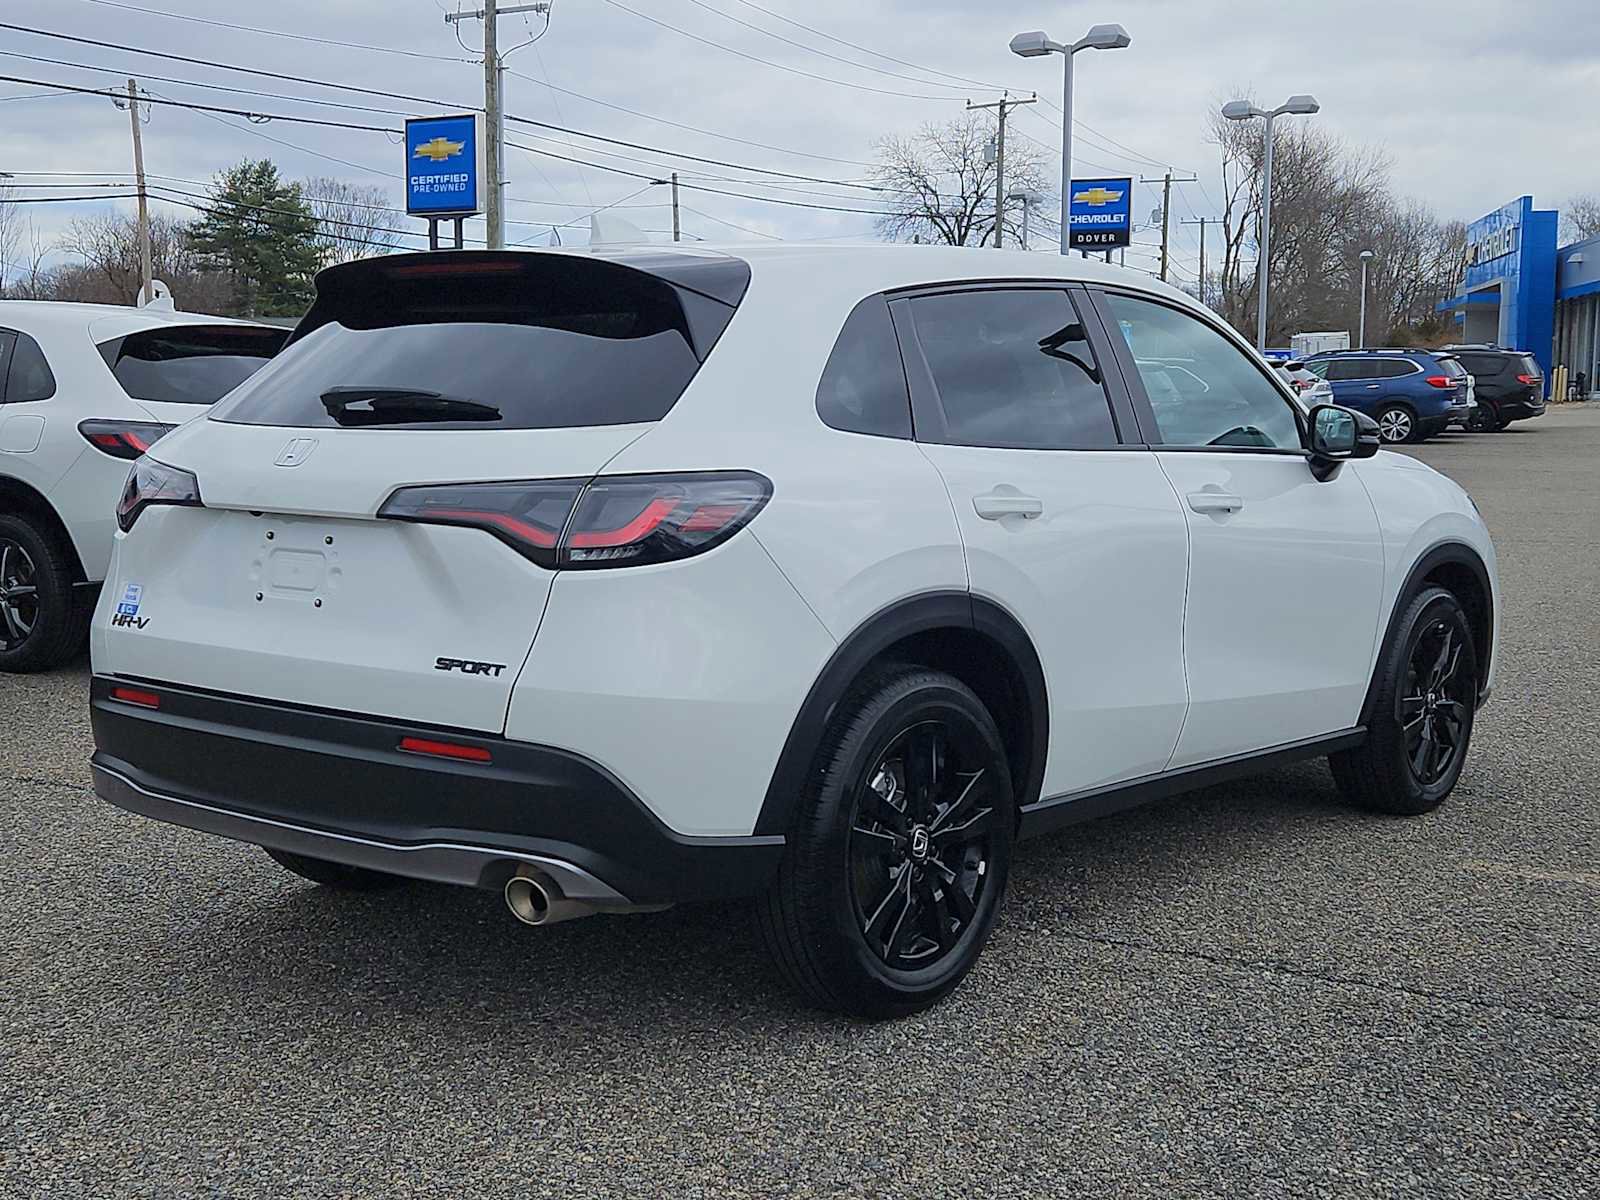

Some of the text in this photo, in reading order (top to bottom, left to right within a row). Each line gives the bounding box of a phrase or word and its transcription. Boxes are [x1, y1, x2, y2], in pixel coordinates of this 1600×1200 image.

[411, 173, 469, 185] CERTIFIED
[413, 182, 466, 193] PRE-OWNED
[1069, 214, 1126, 224] CHEVROLET
[1077, 234, 1115, 242] DOVER
[112, 613, 151, 629] HR-V
[434, 657, 507, 677] SPORT
